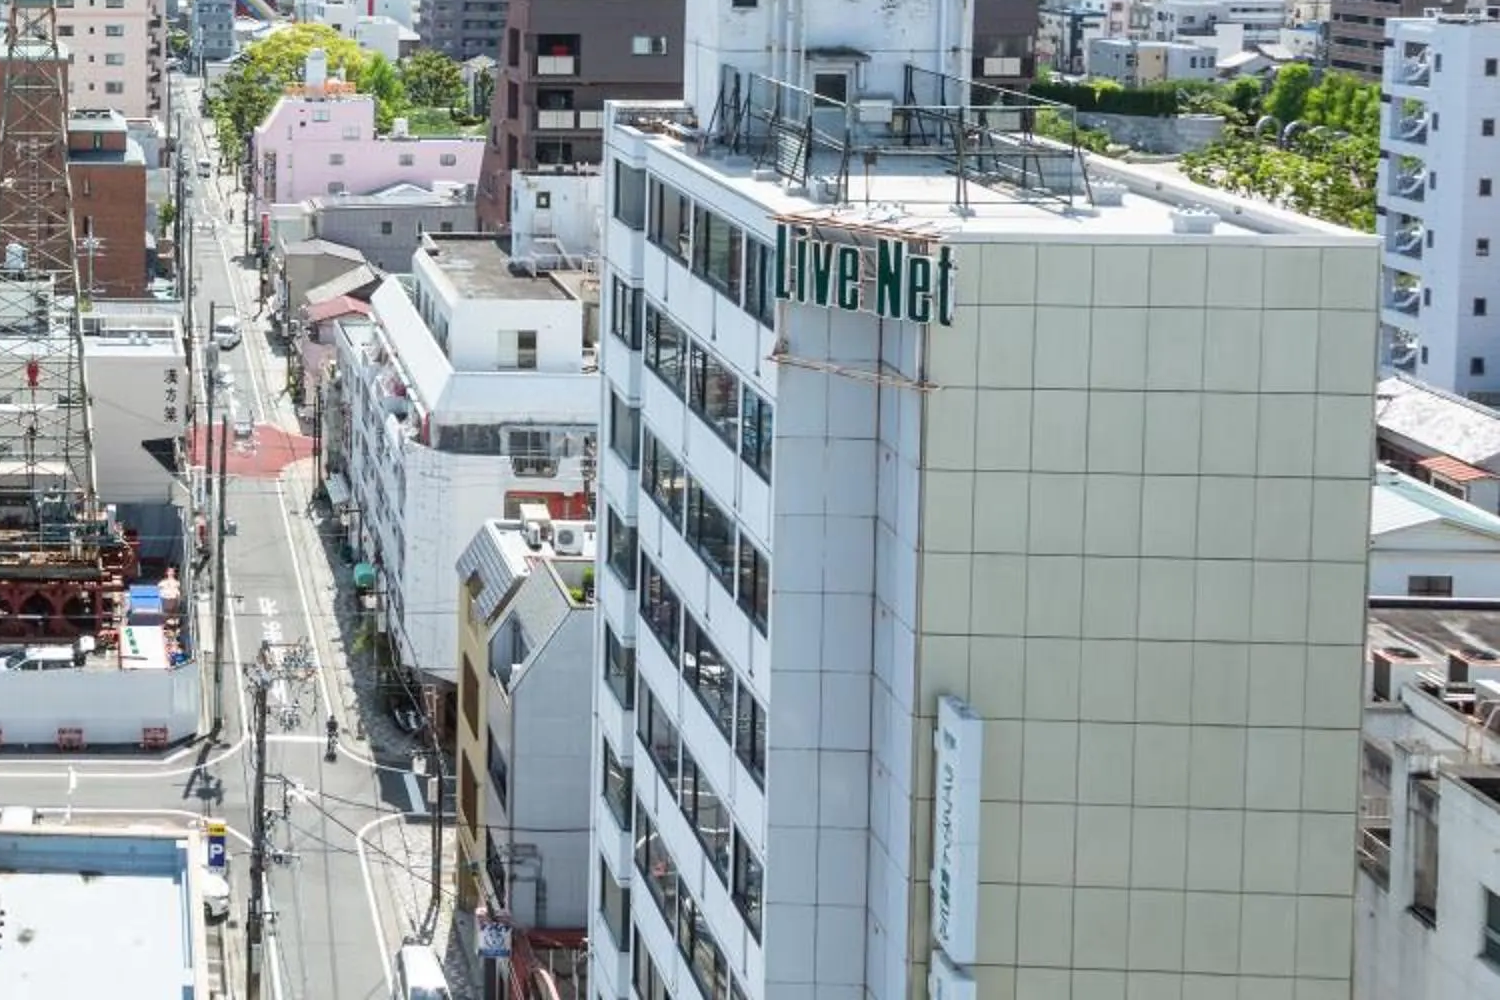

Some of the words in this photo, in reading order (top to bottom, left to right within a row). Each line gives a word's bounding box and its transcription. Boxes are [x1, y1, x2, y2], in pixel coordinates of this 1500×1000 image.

[775, 223, 861, 311] Live
[877, 238, 954, 327] Net
[210, 843, 223, 859] P
